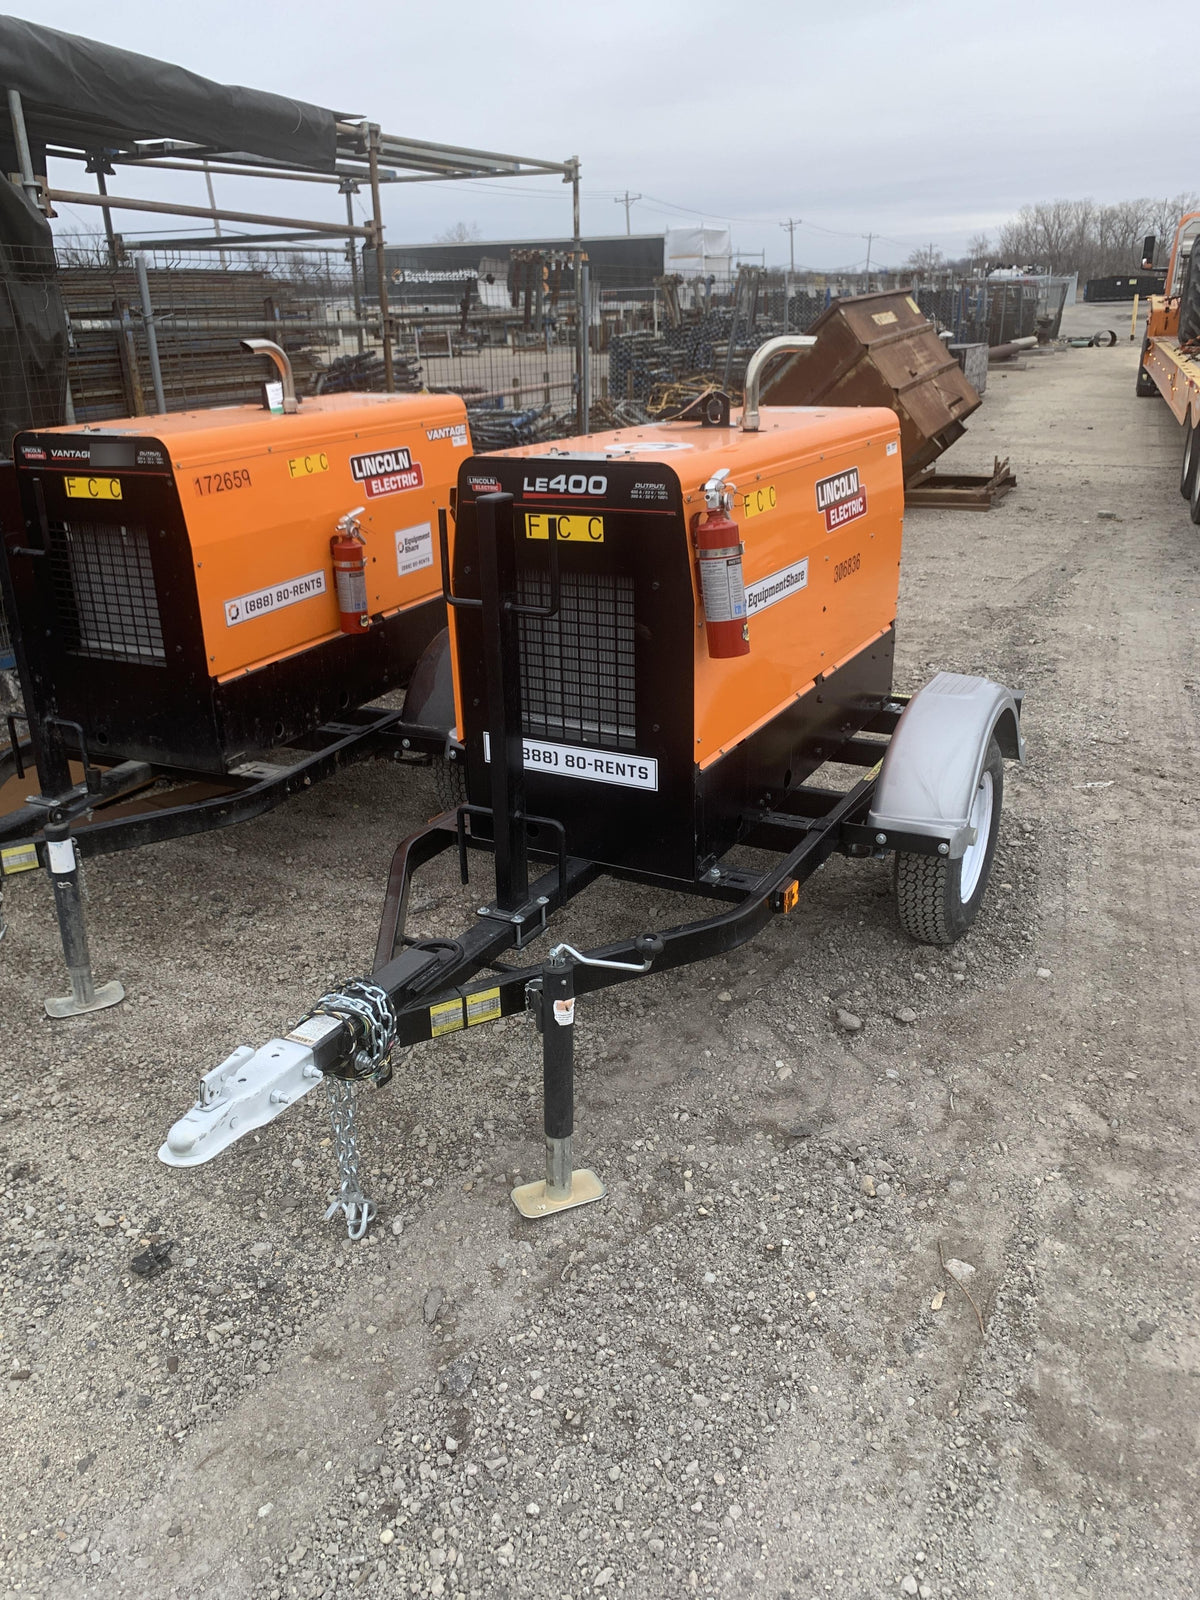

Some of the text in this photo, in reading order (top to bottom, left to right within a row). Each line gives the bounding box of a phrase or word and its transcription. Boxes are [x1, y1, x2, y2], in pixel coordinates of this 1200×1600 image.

[426, 424, 466, 440] VANTAGE
[353, 450, 410, 478] LINCOLN
[194, 469, 252, 496] 172659
[371, 472, 418, 494] ELECTRIC
[468, 477, 495, 485] LINCOLN
[523, 474, 608, 495] LE400
[818, 472, 858, 507] LINCOLN
[830, 497, 863, 526] ELECTRIC
[833, 553, 861, 583] 306836
[245, 593, 273, 614] (888)
[276, 577, 322, 602] 80-RENTS
[748, 569, 805, 608] EquipmentShare
[523, 747, 649, 780] 888) 80-RENTS
